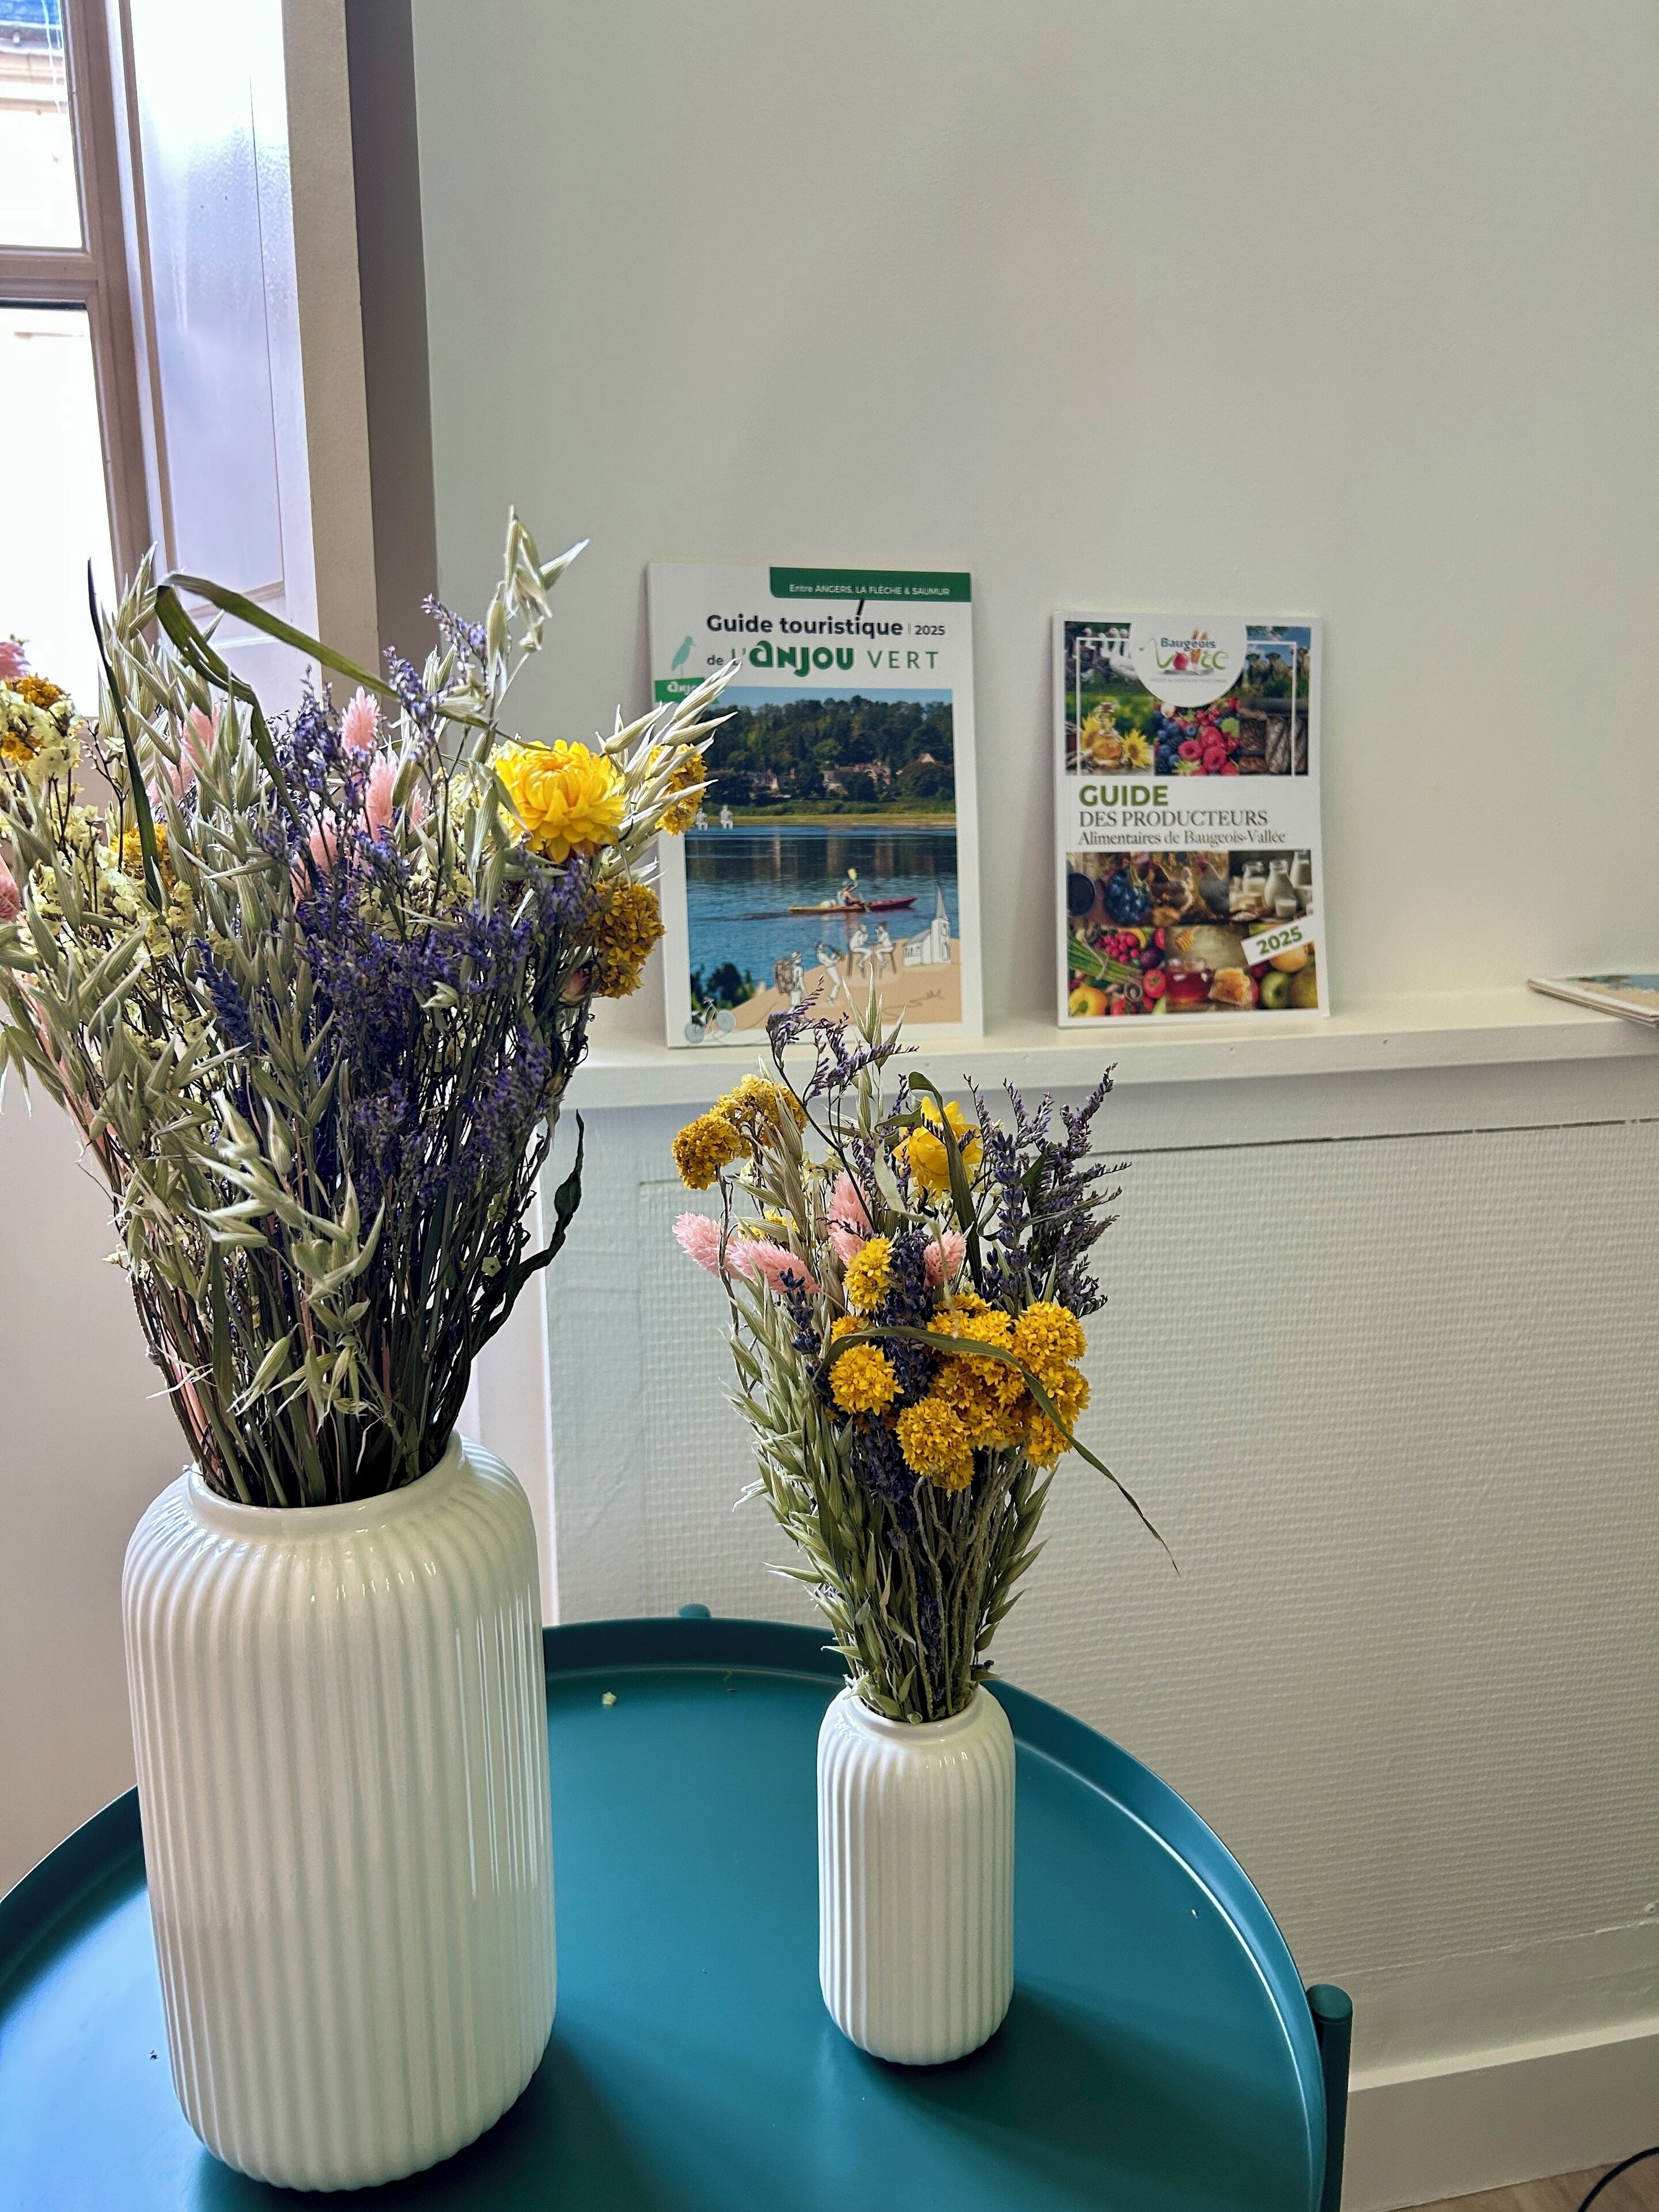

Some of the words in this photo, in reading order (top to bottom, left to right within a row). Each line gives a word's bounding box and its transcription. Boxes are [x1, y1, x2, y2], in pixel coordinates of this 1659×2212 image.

[789, 584, 813, 593] Entre
[815, 585, 854, 594] ANGERS,
[855, 586, 866, 594] LA
[868, 585, 902, 595] FLÈCHE
[904, 587, 910, 595] &
[911, 587, 950, 596] SAUMUR
[707, 615, 772, 633] Guide
[780, 616, 903, 639] touristique
[915, 625, 945, 636] 2025
[1160, 637, 1217, 651] Baugeois
[707, 654, 724, 665] de
[868, 651, 939, 669] VERT
[1078, 785, 1169, 807] GUIDE
[1080, 811, 1117, 827] DES
[1122, 810, 1268, 827] PRODUCTEURS
[1078, 831, 1161, 846] Alimentaires
[1164, 831, 1180, 844] de
[1184, 829, 1286, 848] Baugeois-Vallée
[1256, 926, 1303, 956] 2025
